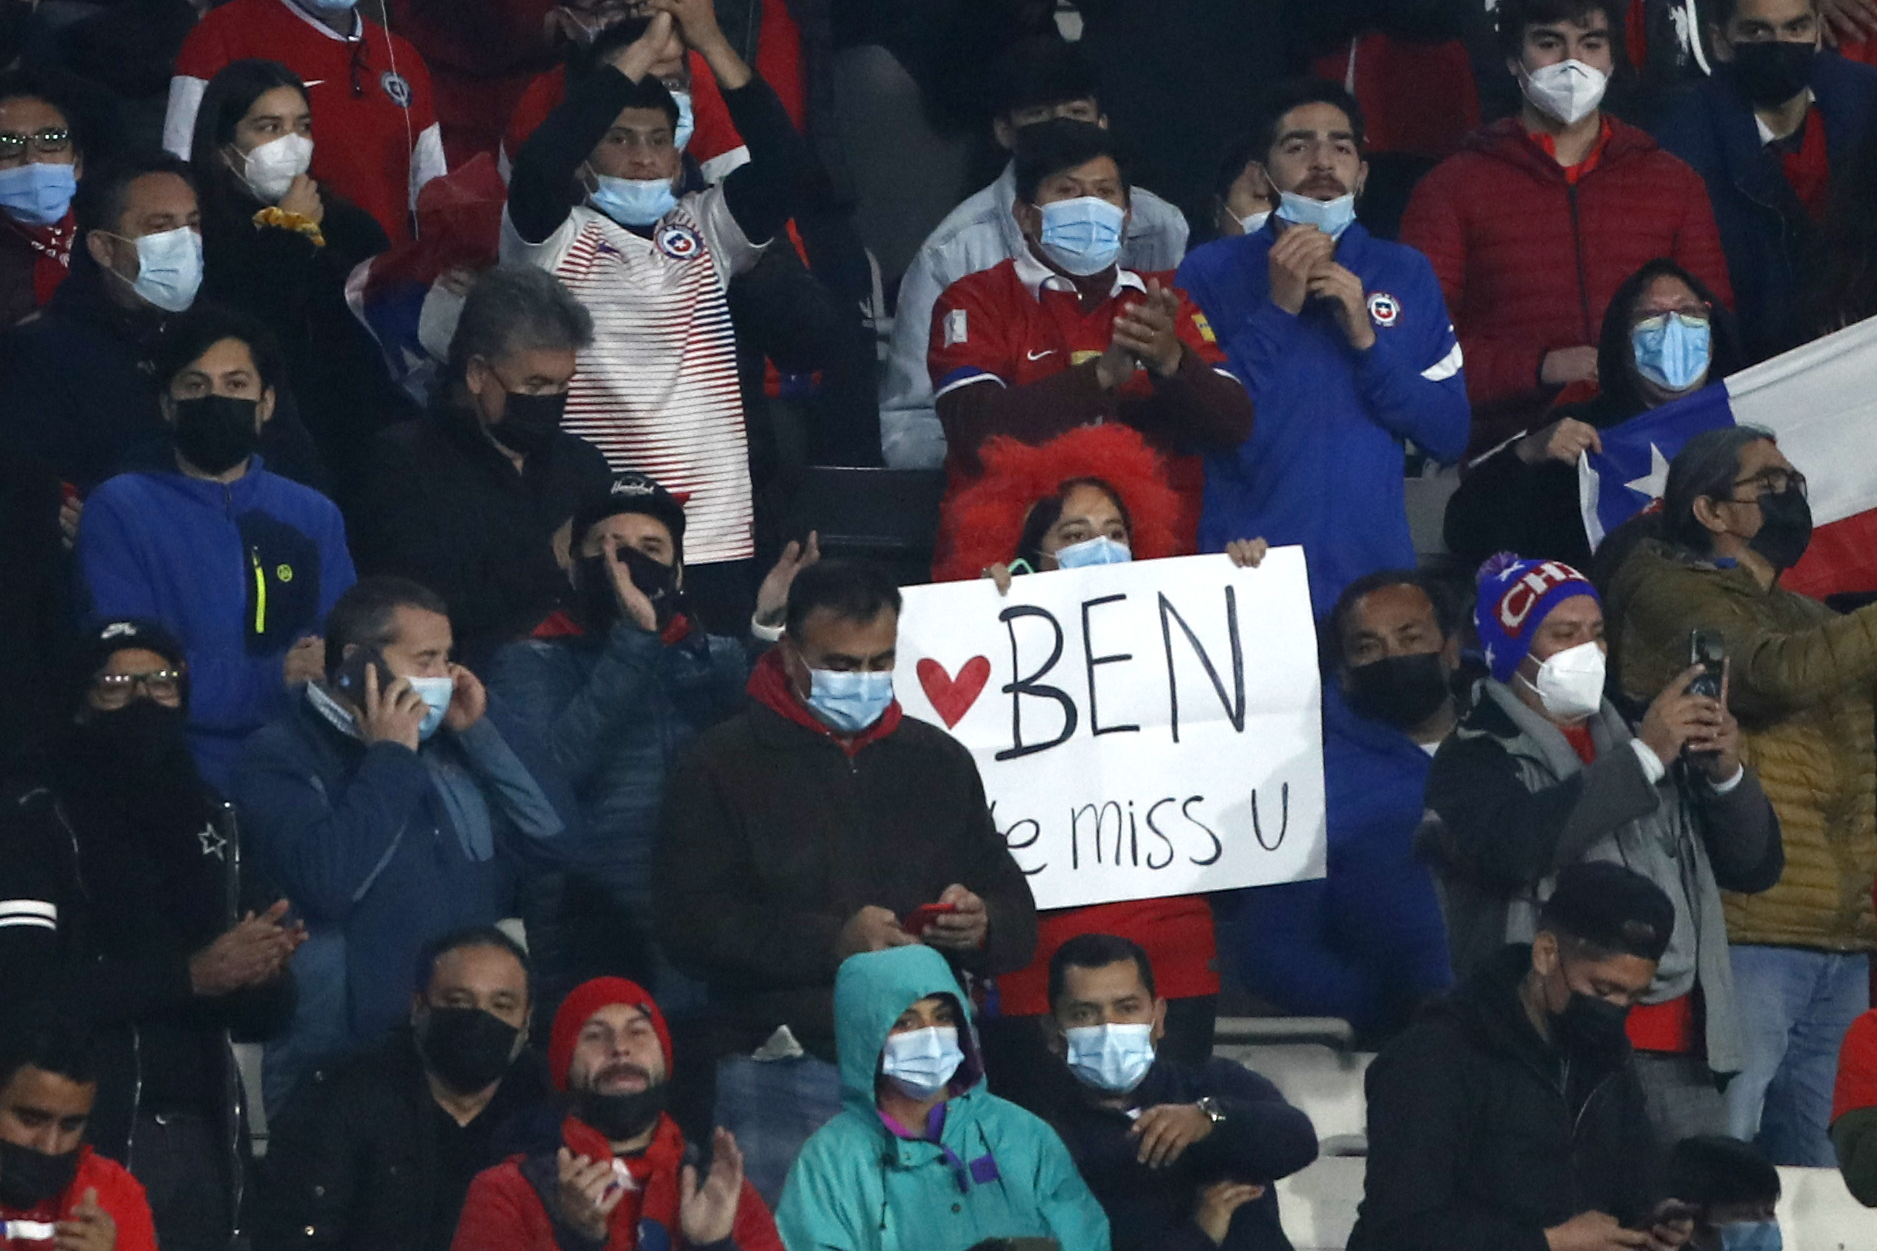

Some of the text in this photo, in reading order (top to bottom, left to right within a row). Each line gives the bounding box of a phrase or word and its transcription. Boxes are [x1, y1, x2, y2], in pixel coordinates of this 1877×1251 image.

[995, 585, 1246, 761] BEN
[988, 799, 1047, 875] e
[1072, 795, 1222, 870] miss
